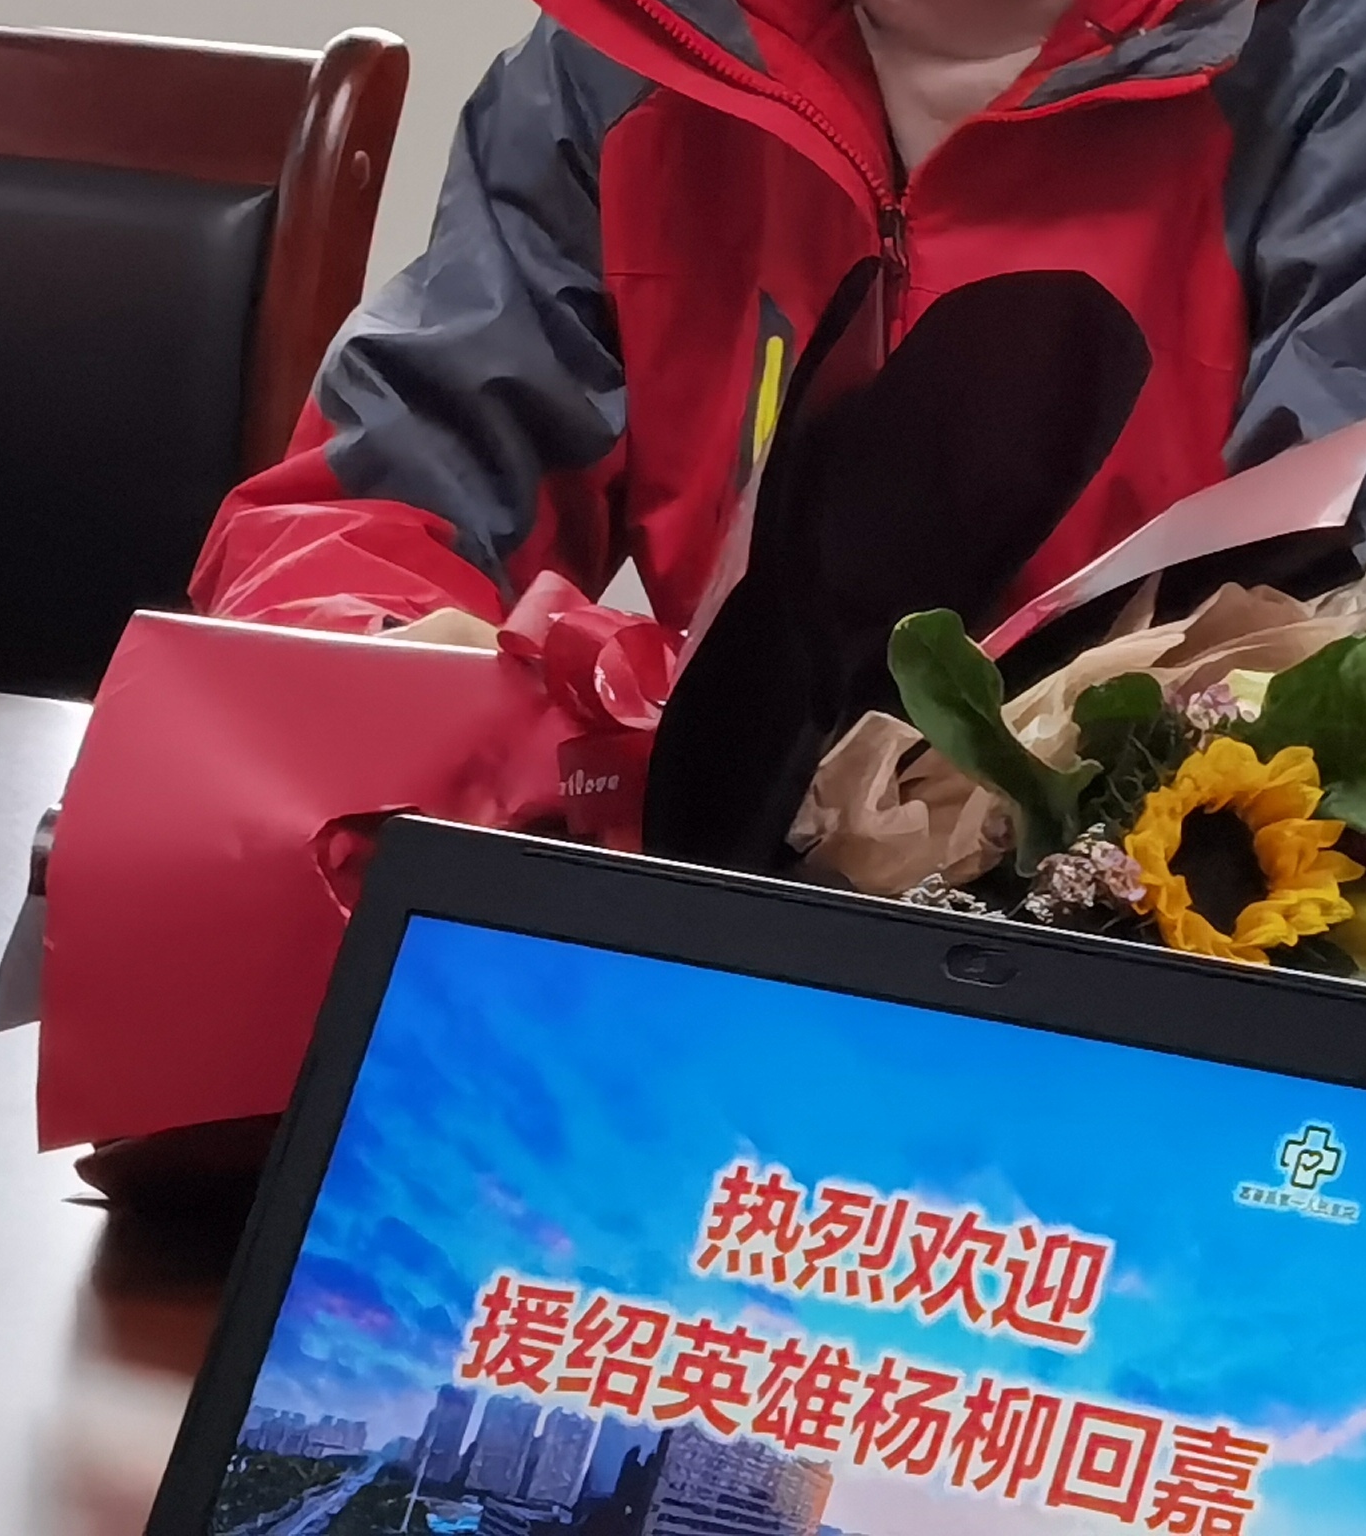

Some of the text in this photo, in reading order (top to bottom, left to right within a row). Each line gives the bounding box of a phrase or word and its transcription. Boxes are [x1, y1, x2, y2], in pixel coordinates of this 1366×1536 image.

[697, 1165, 1110, 1347] 热烈欢迎
[462, 1275, 1269, 1536] 援绍英雄杨柳回嘉
